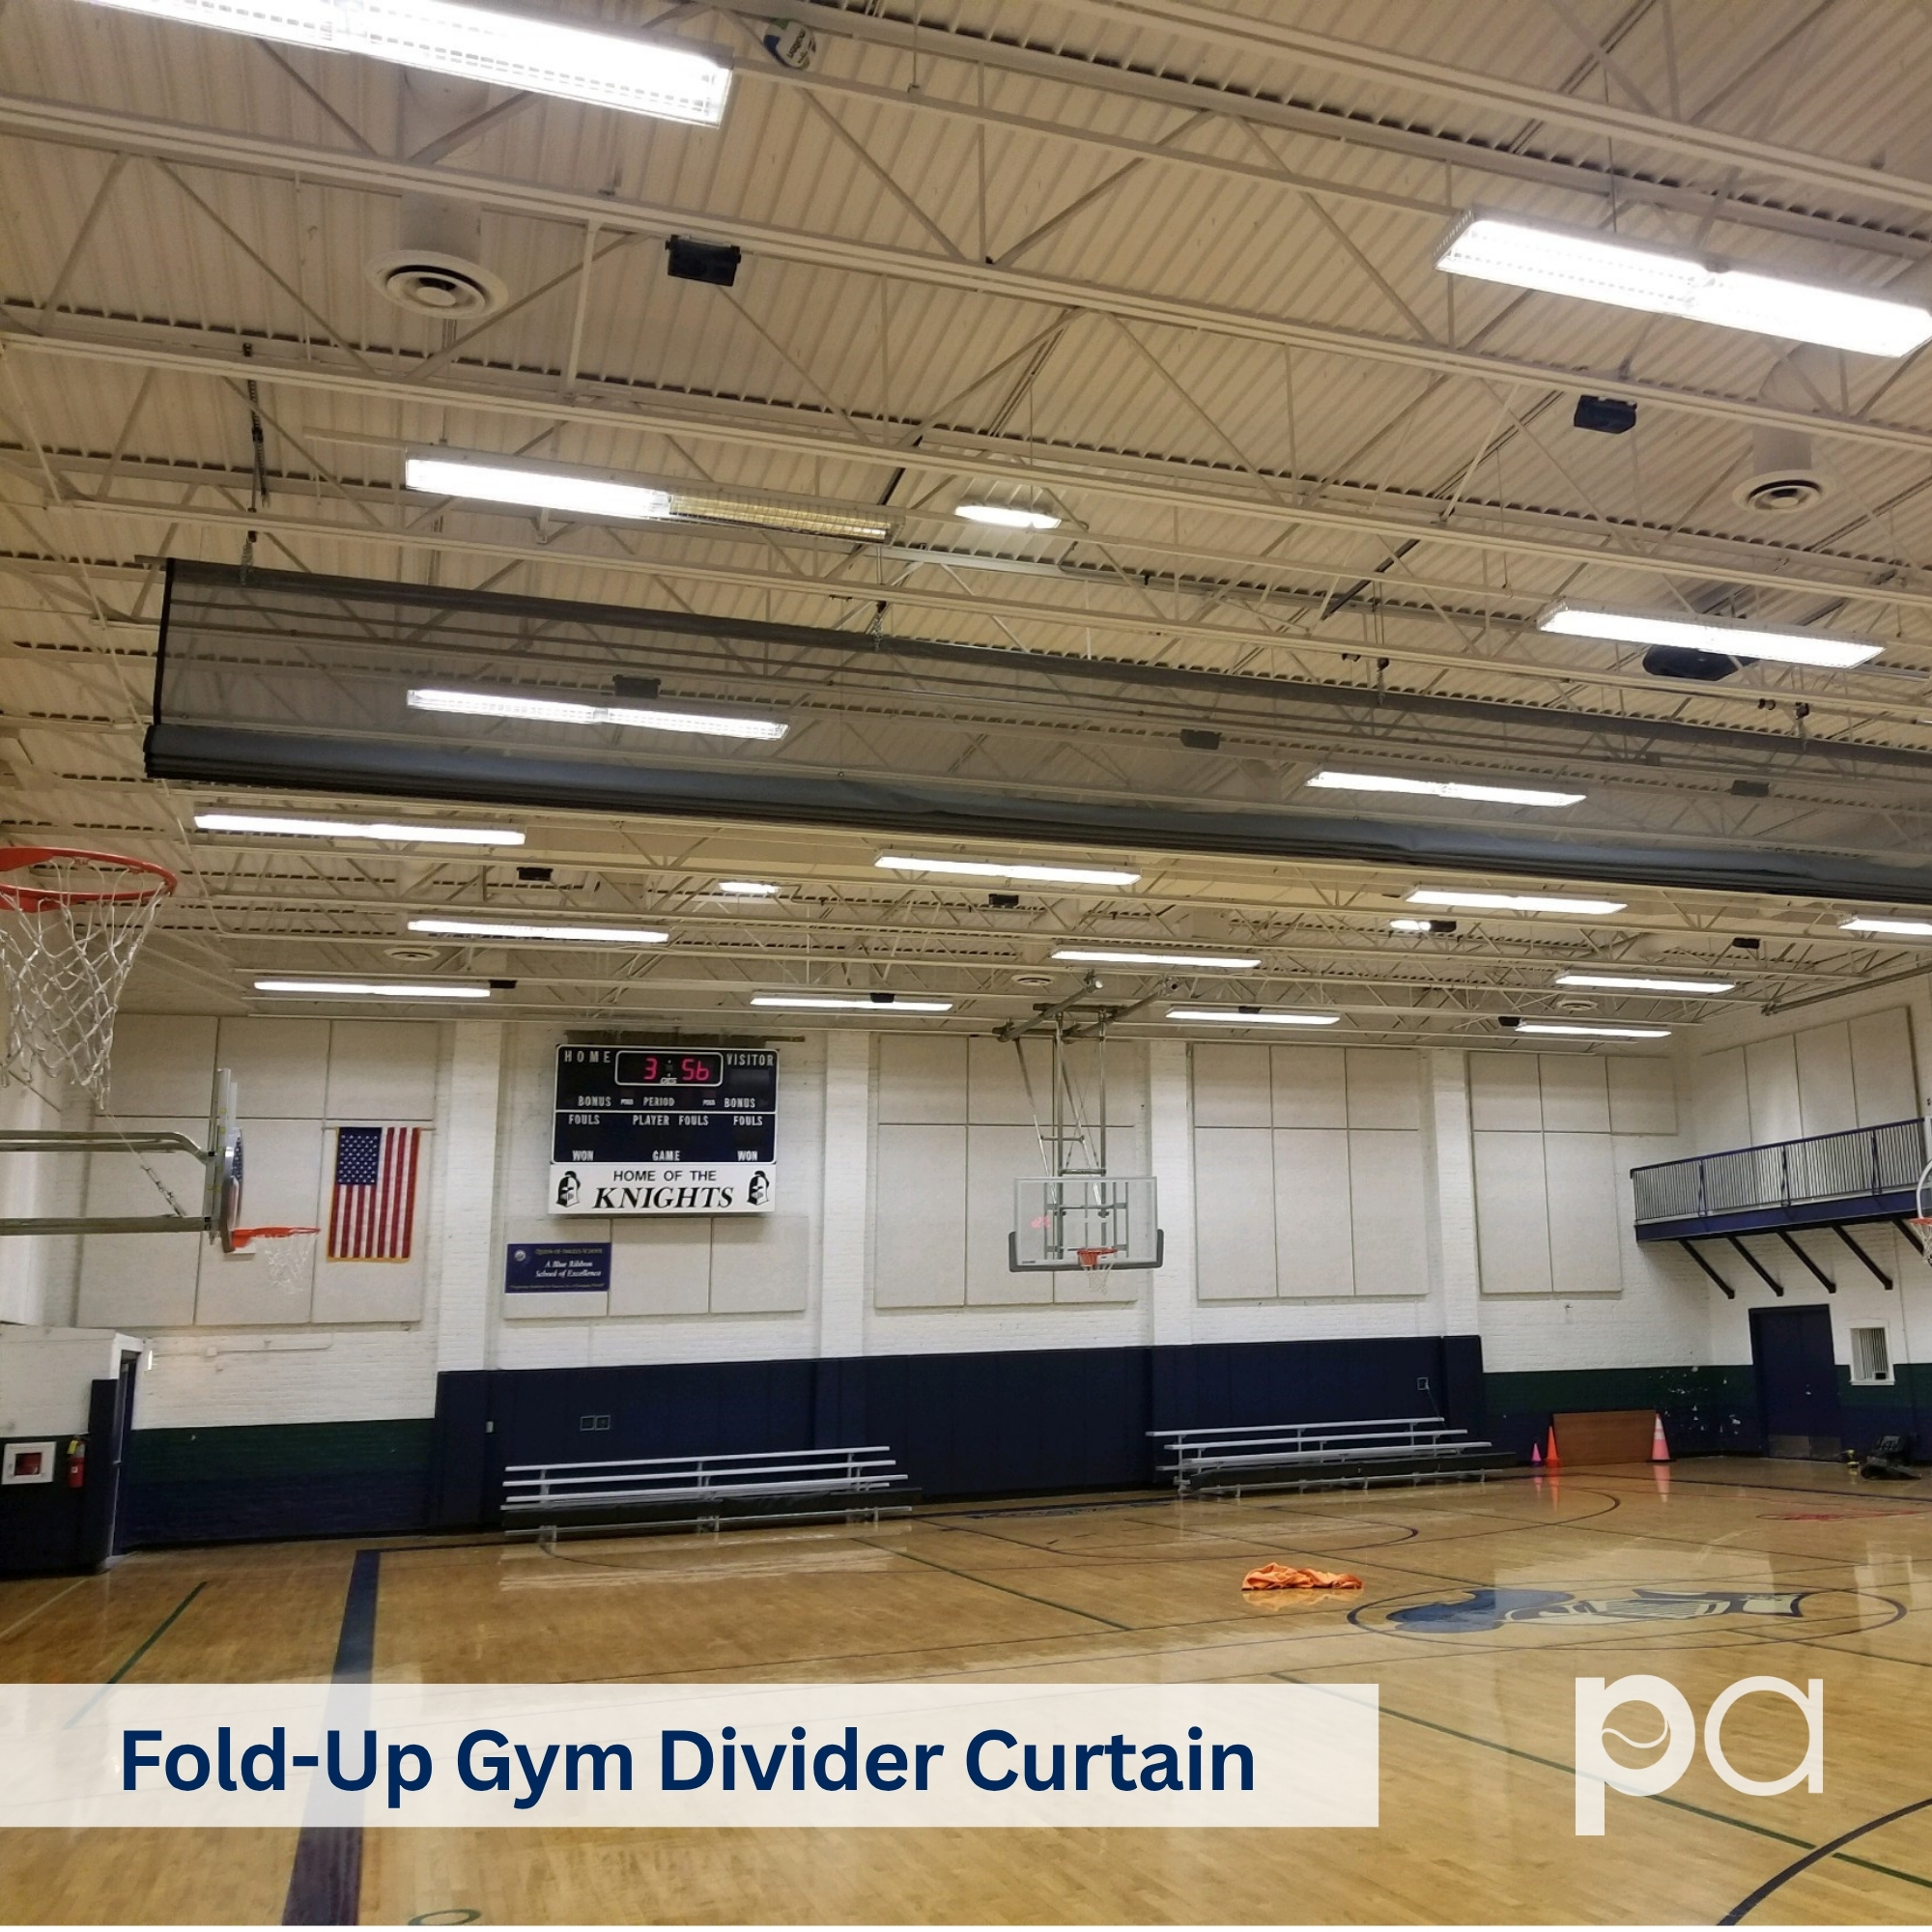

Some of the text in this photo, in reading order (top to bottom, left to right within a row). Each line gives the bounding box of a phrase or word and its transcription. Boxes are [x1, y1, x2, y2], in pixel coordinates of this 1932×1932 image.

[564, 1050, 611, 1063] HOME
[726, 1053, 773, 1066] VISITOR
[578, 1095, 611, 1107] BONUS
[642, 1096, 675, 1107] PERIOD
[724, 1097, 755, 1108] BONUS
[568, 1114, 600, 1125] FOULS
[633, 1115, 709, 1125] PLAYER FOULS
[733, 1116, 763, 1126] FOULS
[572, 1150, 594, 1161] WON
[652, 1150, 680, 1161] GAME
[737, 1150, 758, 1161] WON
[613, 1170, 717, 1181] HOME OF THE
[592, 1186, 734, 1208] KNIGHTS
[557, 1269, 567, 1278] of
